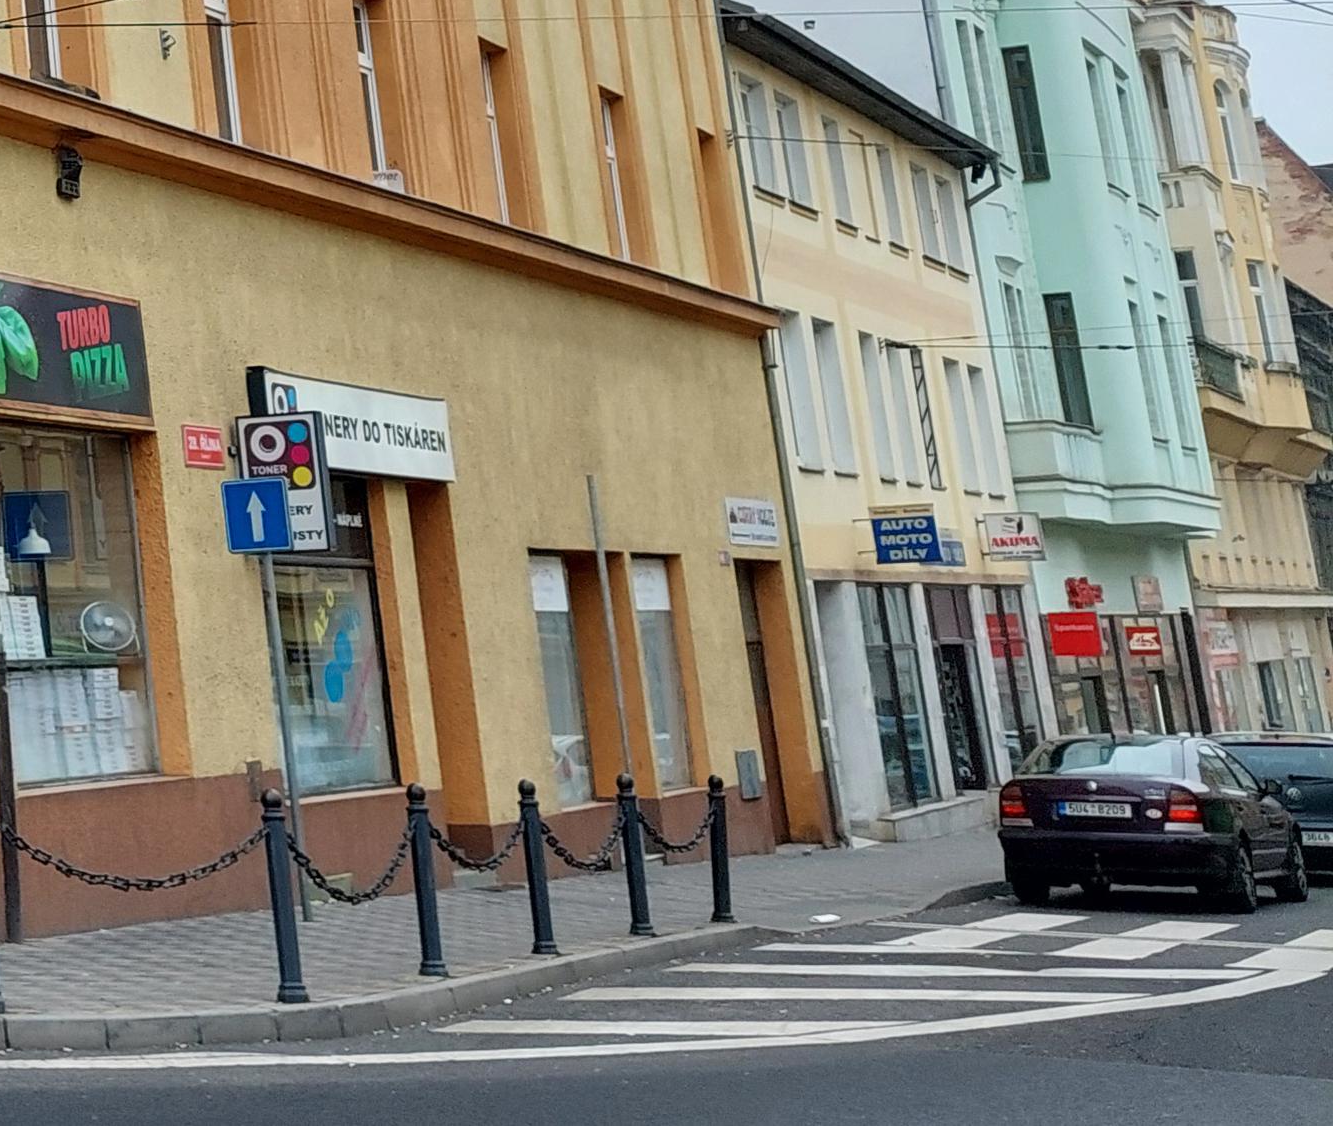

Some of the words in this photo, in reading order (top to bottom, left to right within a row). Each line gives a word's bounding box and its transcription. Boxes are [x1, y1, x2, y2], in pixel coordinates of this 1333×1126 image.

[56, 304, 111, 351] TURBO
[70, 343, 131, 402] PIZZA
[323, 412, 359, 442] NERY
[362, 420, 381, 444] DO
[384, 422, 447, 454] TISKÁREN
[251, 464, 288, 475] TONER
[880, 519, 928, 532] AUTO
[880, 533, 933, 546] MOTO
[991, 536, 1041, 548] AKUMA
[889, 546, 930, 561] DÍLY
